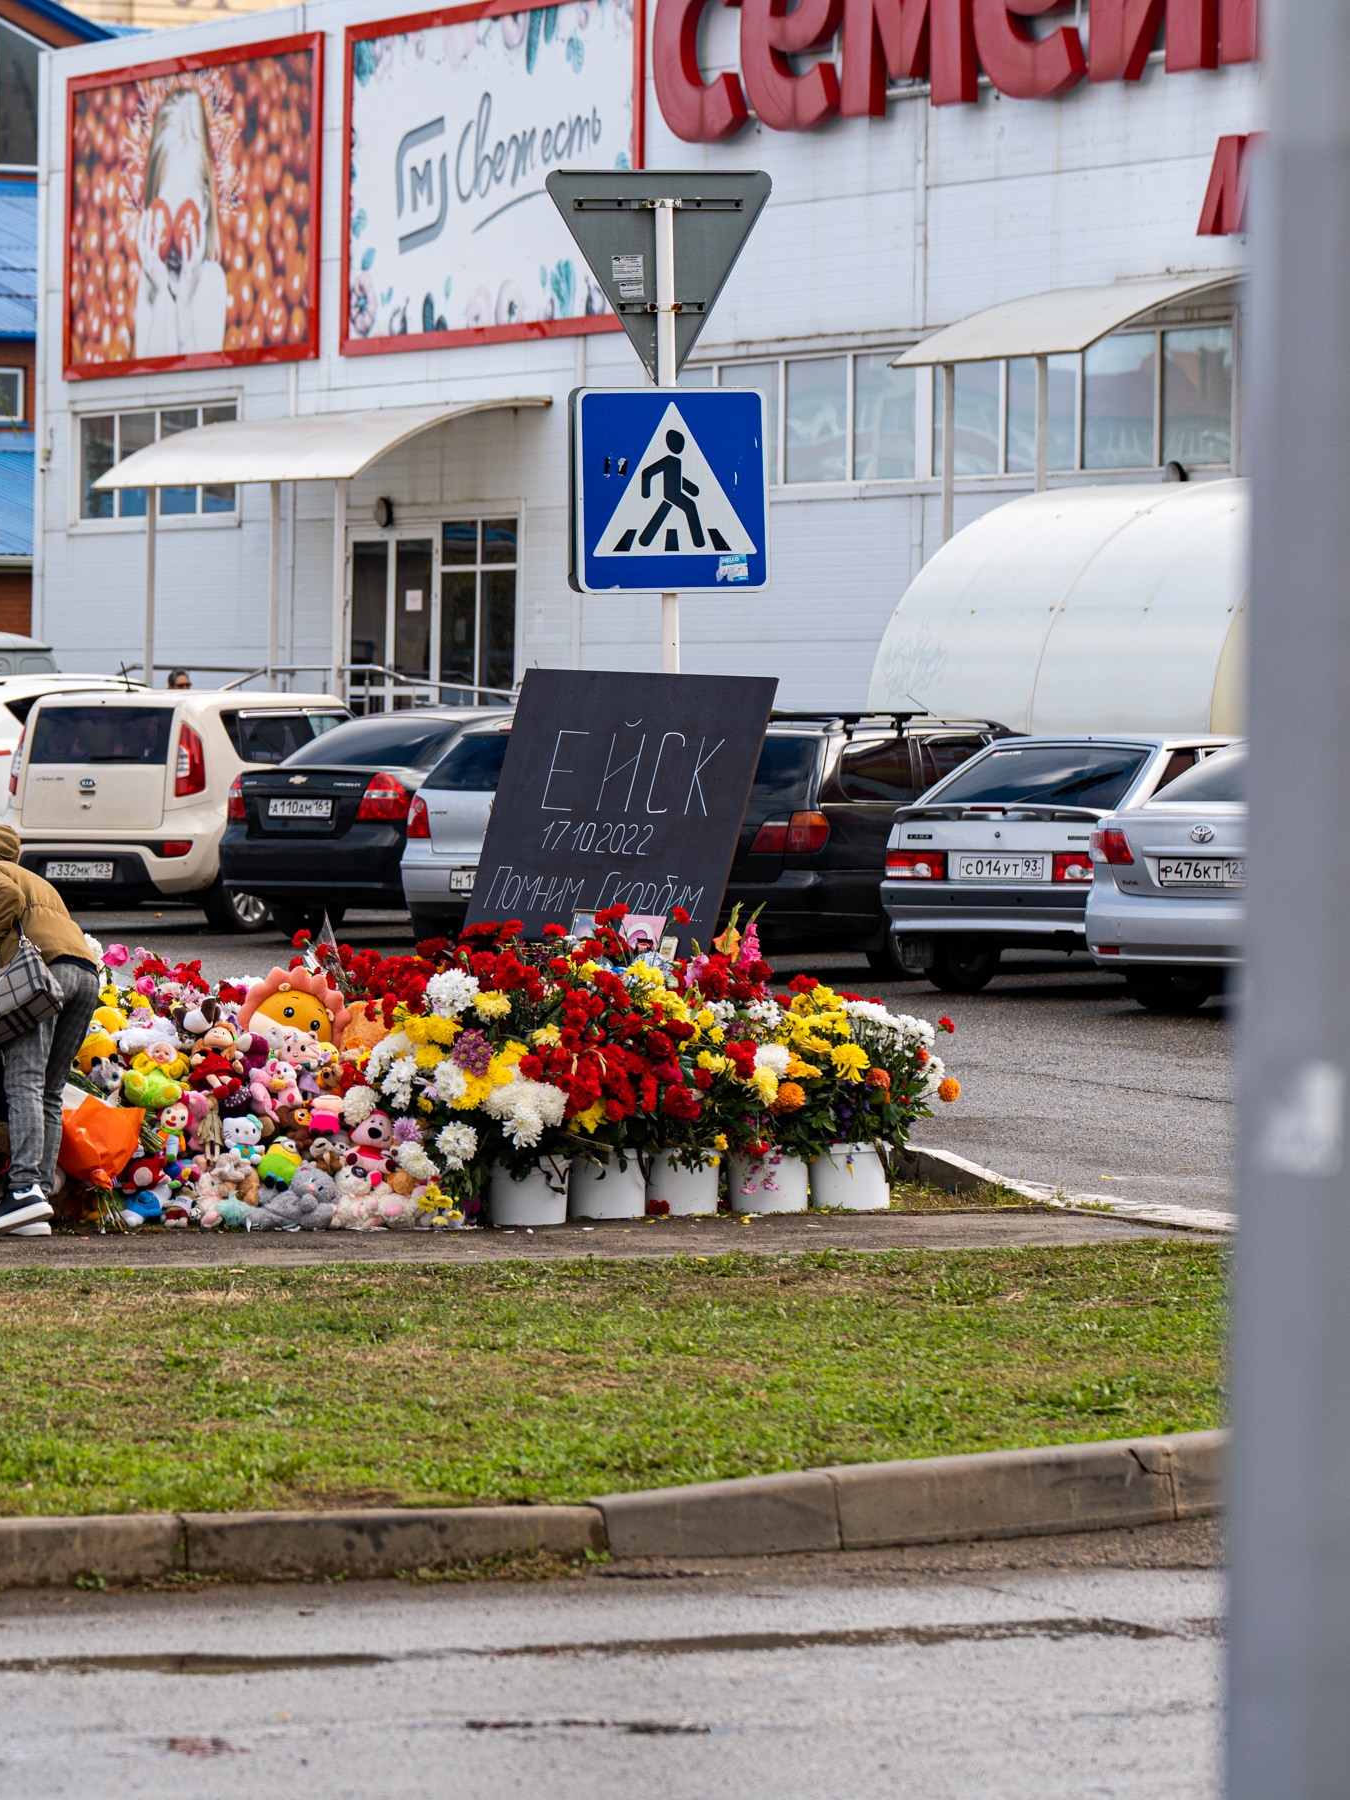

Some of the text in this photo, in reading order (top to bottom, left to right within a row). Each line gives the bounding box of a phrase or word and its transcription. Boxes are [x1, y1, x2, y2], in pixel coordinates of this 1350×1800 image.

[455, 91, 602, 204] Свежесть
[541, 718, 726, 817] ЕЙСК
[271, 801, 329, 814] А110АМ 161
[50, 863, 110, 877] Т332МК 123
[965, 859, 1038, 876] С014УТ 93
[1164, 862, 1221, 879] Р476КТ
